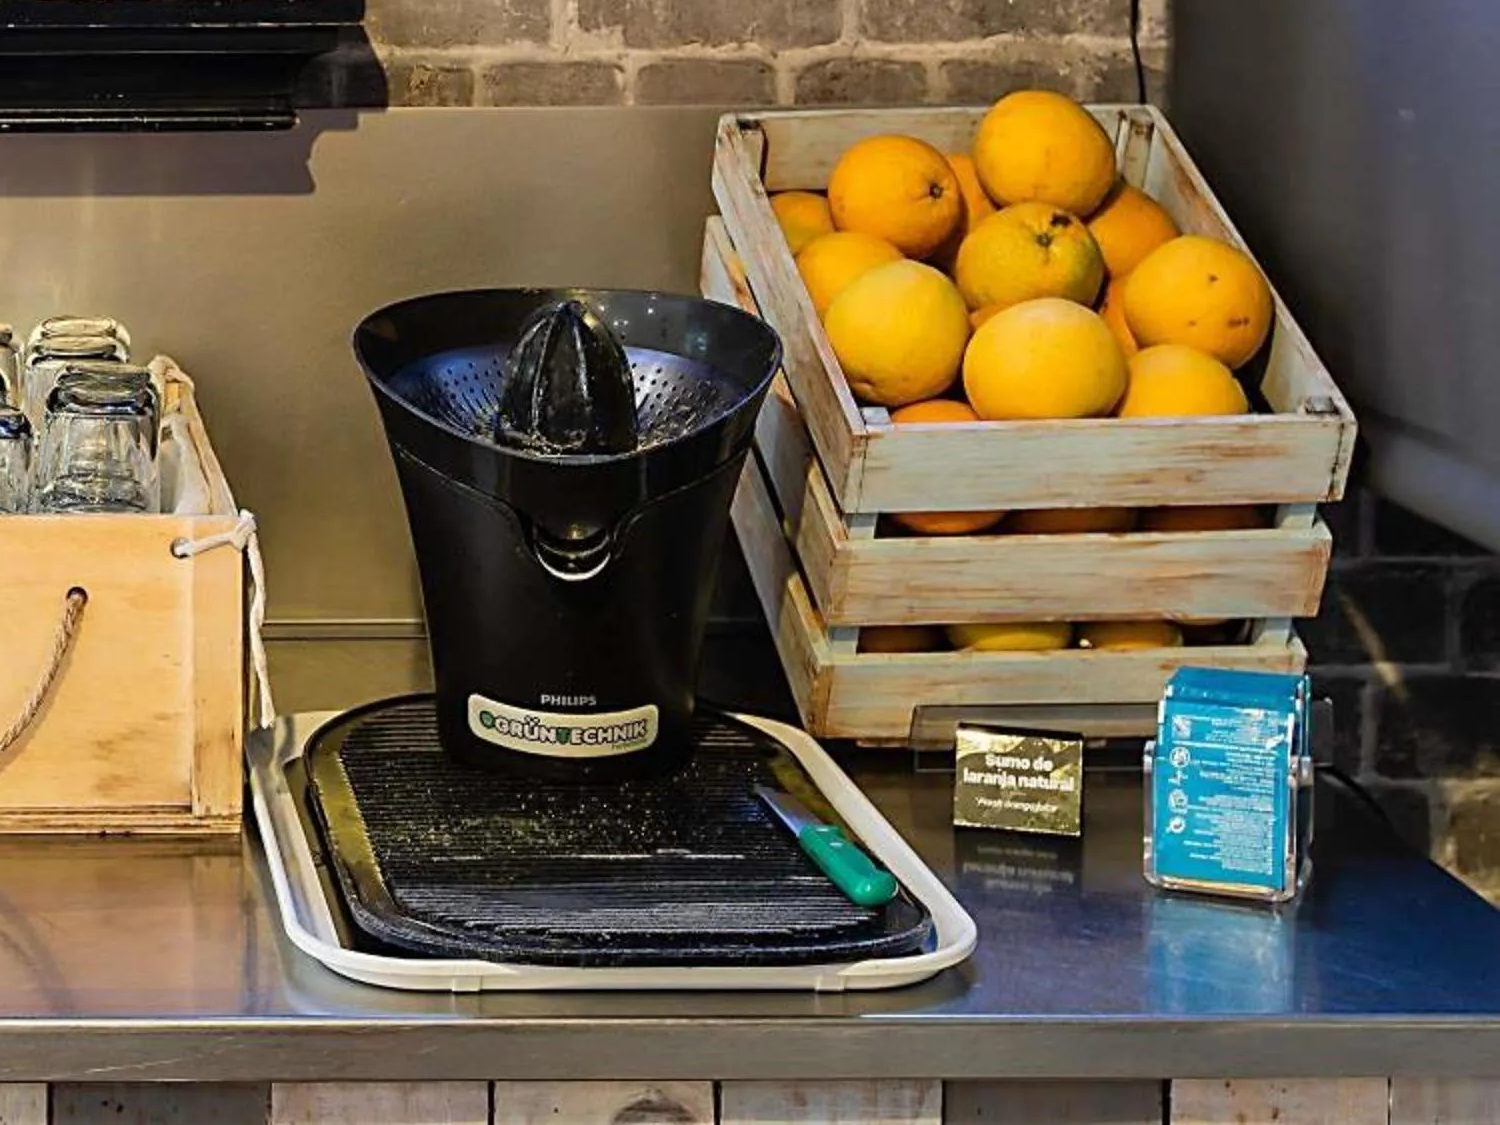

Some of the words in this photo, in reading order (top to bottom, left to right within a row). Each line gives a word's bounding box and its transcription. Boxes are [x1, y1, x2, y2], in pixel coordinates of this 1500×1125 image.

[540, 694, 597, 706] PHILIPS
[495, 715, 648, 745] GRÜNTECHNIK
[985, 753, 1031, 770] Sumo
[1033, 756, 1054, 772] de
[963, 766, 1017, 789] laranja
[1018, 773, 1075, 792] natural
